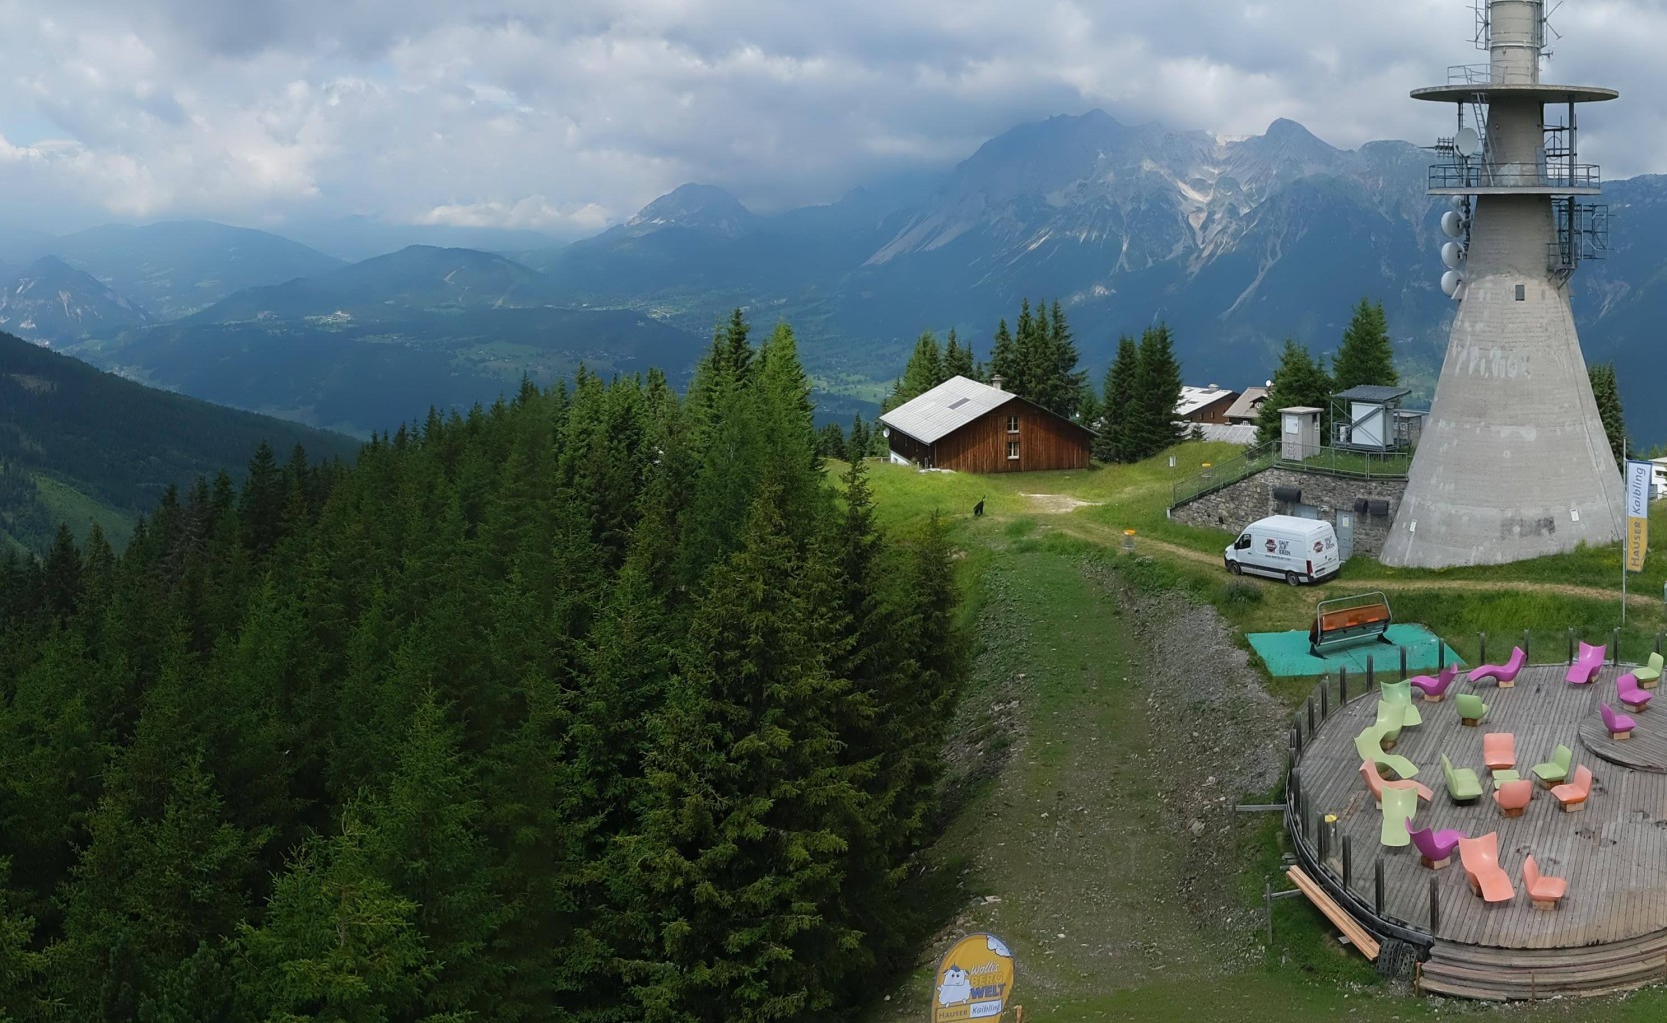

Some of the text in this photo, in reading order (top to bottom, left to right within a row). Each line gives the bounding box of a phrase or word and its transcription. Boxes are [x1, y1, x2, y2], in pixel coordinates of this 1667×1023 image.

[1631, 467, 1646, 567] HAUSER Kaibling
[970, 972, 1003, 987] BERG
[970, 983, 1006, 999] WELT
[939, 1009, 968, 1019] HAUSER
